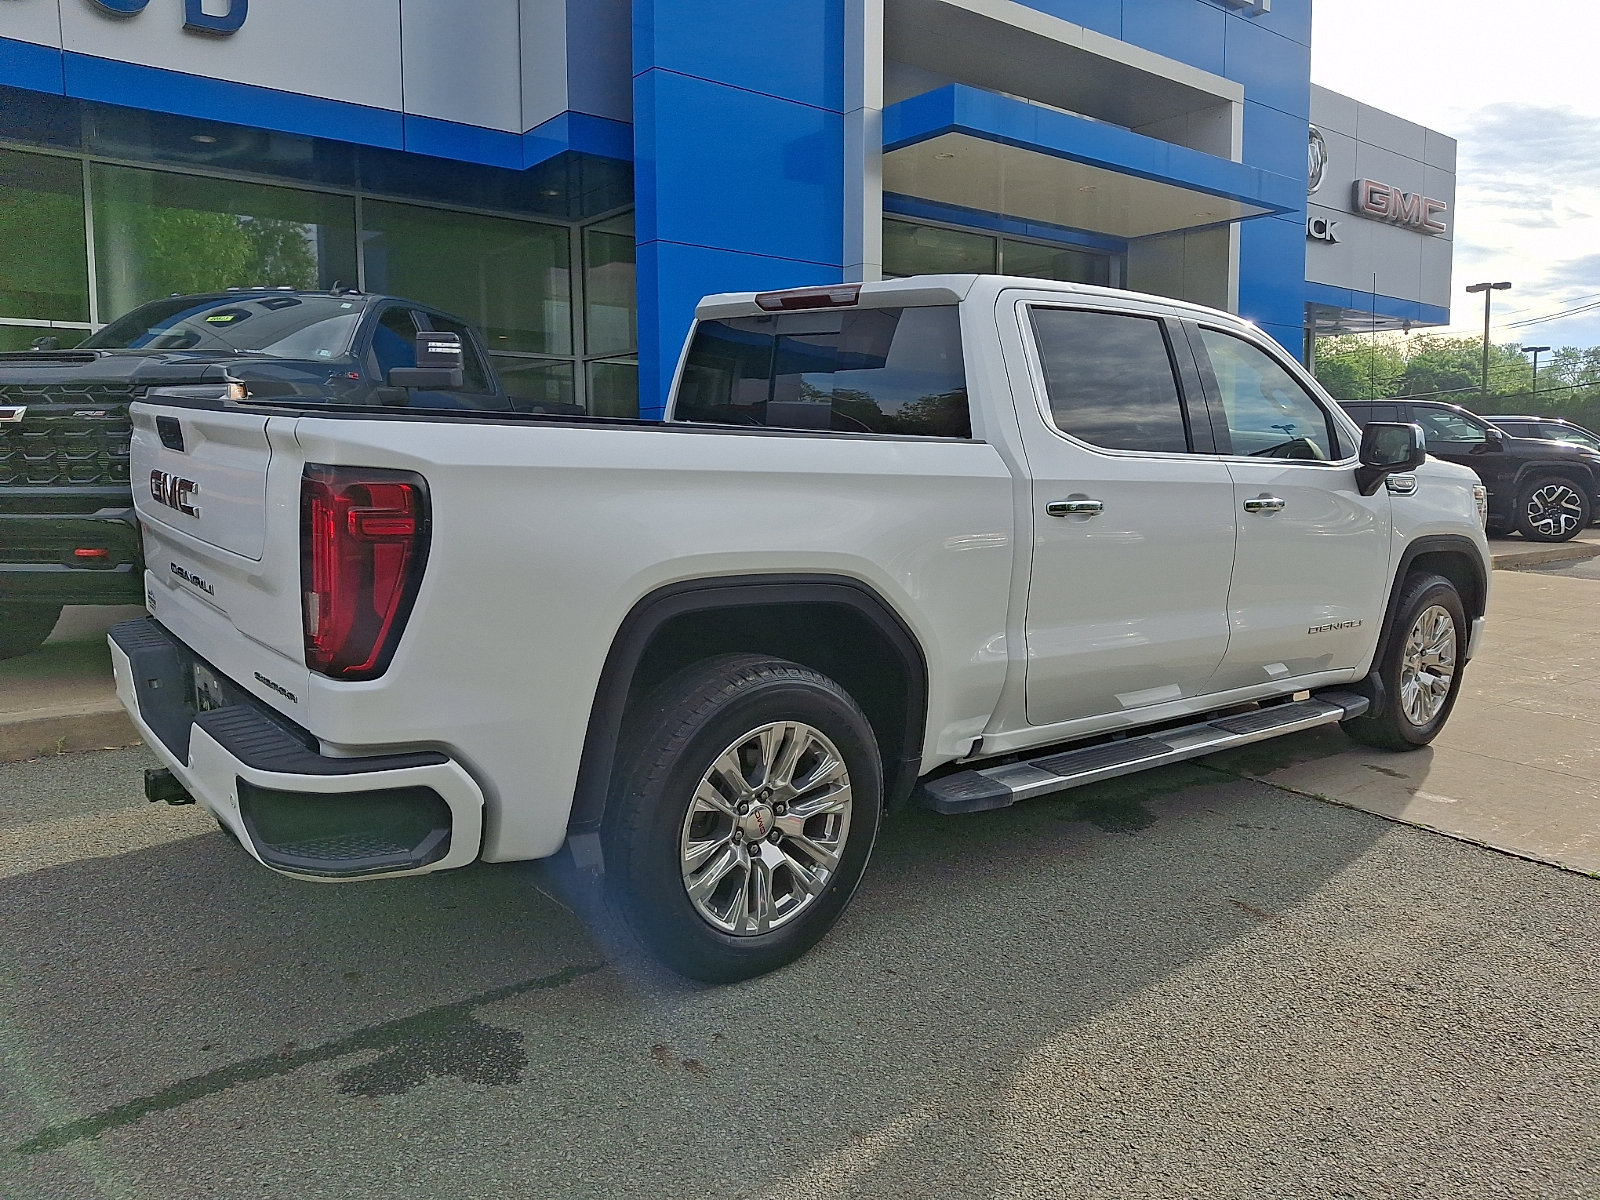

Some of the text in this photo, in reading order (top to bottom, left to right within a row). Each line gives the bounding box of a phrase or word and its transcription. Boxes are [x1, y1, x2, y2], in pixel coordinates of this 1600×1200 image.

[1359, 178, 1447, 234] GMC
[150, 469, 200, 519] GMC
[170, 562, 215, 596] DENALI
[1307, 619, 1363, 634] DENALI
